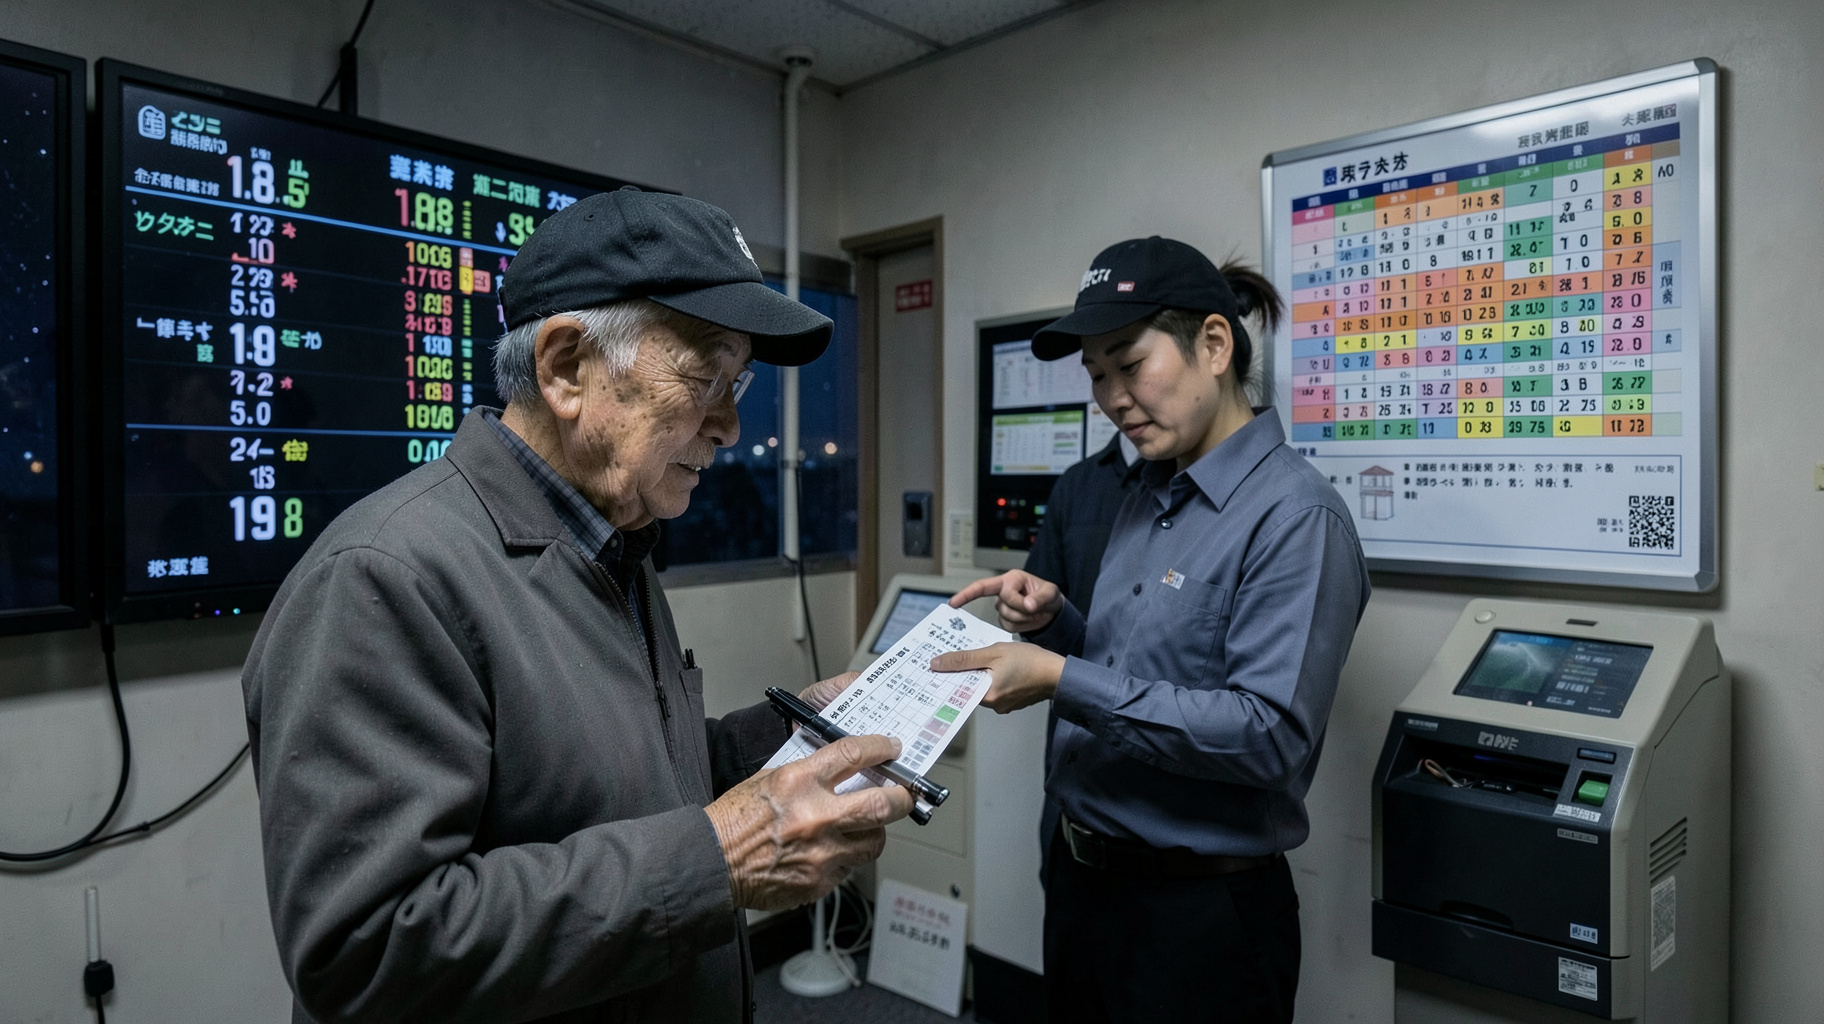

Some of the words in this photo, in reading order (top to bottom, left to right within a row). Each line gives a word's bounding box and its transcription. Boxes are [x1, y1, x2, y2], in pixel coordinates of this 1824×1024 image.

[1570, 179, 1578, 193] 0
[1580, 234, 1588, 247] 0
[1402, 258, 1410, 270] 0
[1430, 255, 1437, 267] 8
[1582, 256, 1590, 268] 0
[1401, 278, 1406, 290] 1
[1425, 275, 1432, 287] 5
[1511, 283, 1527, 296] 21
[1401, 296, 1407, 308] 1
[1631, 293, 1641, 307] 0
[1511, 326, 1519, 337] 7
[1384, 335, 1390, 348] 2
[1581, 340, 1594, 353] 19
[1344, 388, 1349, 400] 1
[1465, 381, 1473, 394] 8
[1480, 381, 1487, 393] 0
[230, 400, 272, 426] 5.0
[1465, 421, 1472, 433] 0
[1530, 421, 1545, 434] 75
[229, 495, 276, 542] 19
[283, 497, 303, 539] 8
